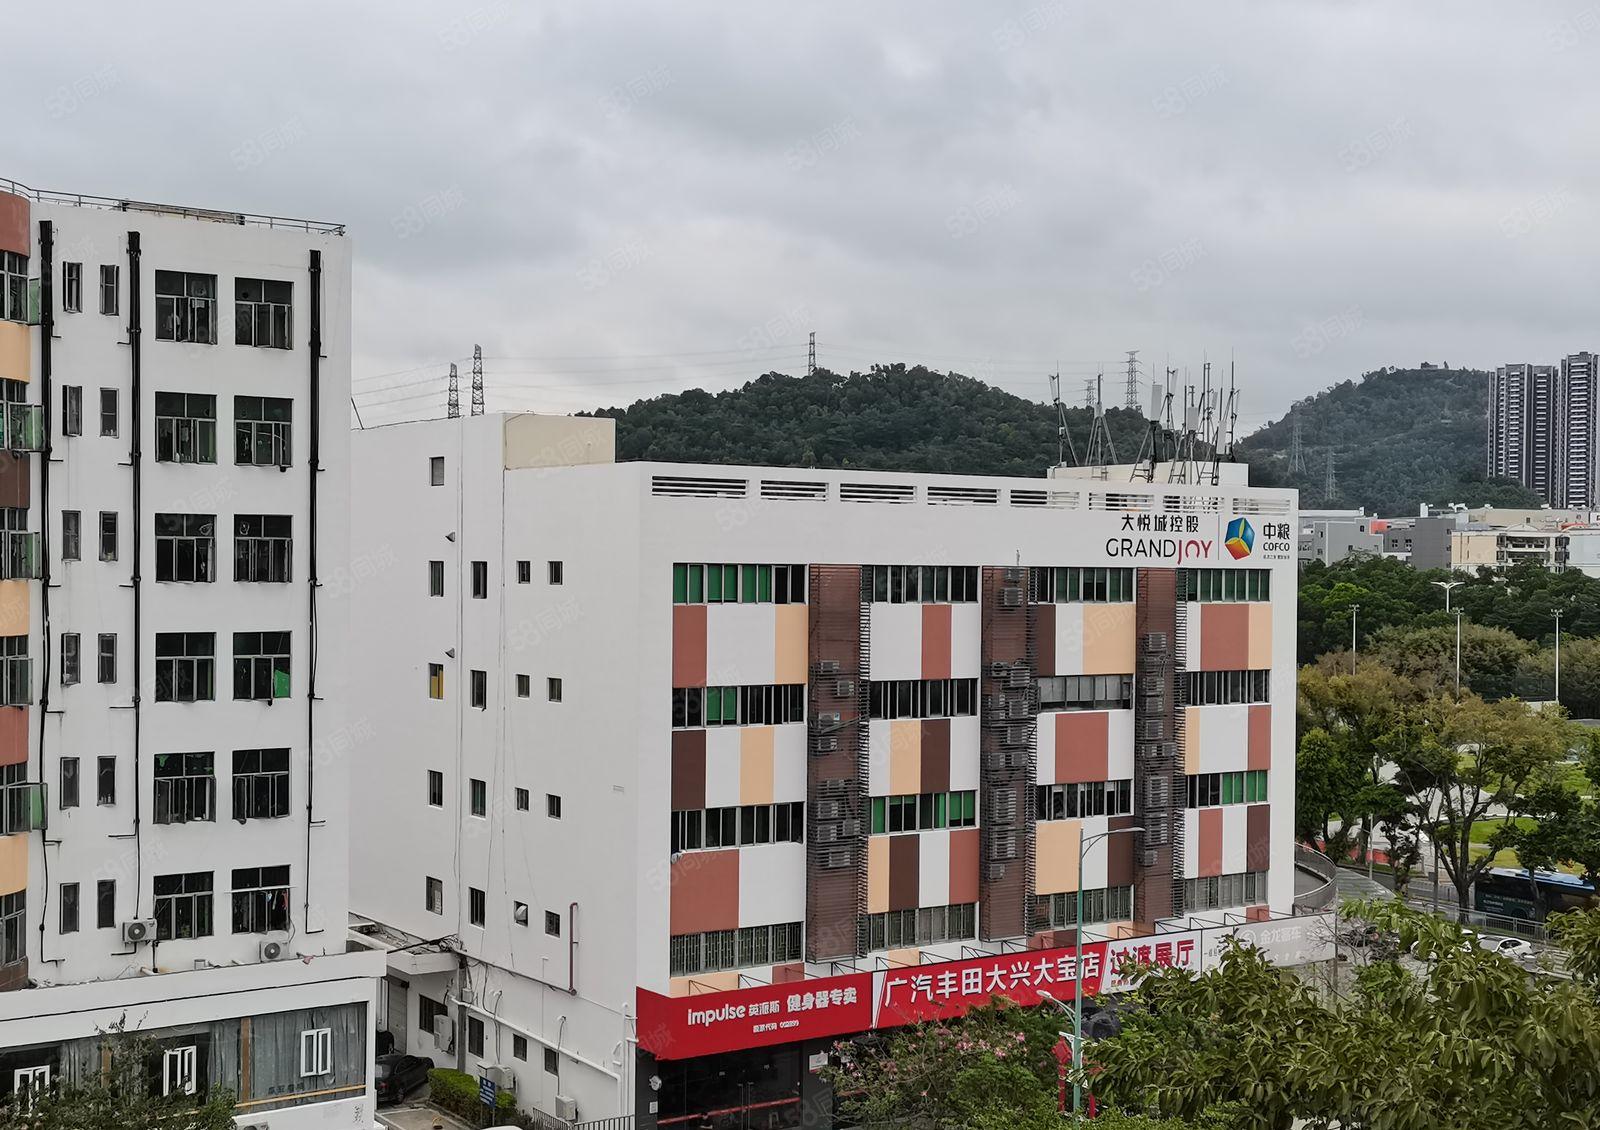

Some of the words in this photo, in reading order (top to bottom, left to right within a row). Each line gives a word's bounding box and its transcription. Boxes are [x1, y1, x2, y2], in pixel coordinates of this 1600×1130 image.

[1121, 514, 1199, 532] 大悦城控股
[1263, 522, 1290, 540] 中粮
[1106, 538, 1213, 565] GRANDJOY
[1263, 542, 1290, 551] COFCO
[884, 952, 1100, 1008] 广汽丰田大兴大宝店
[787, 987, 857, 1012] 健身器专卖
